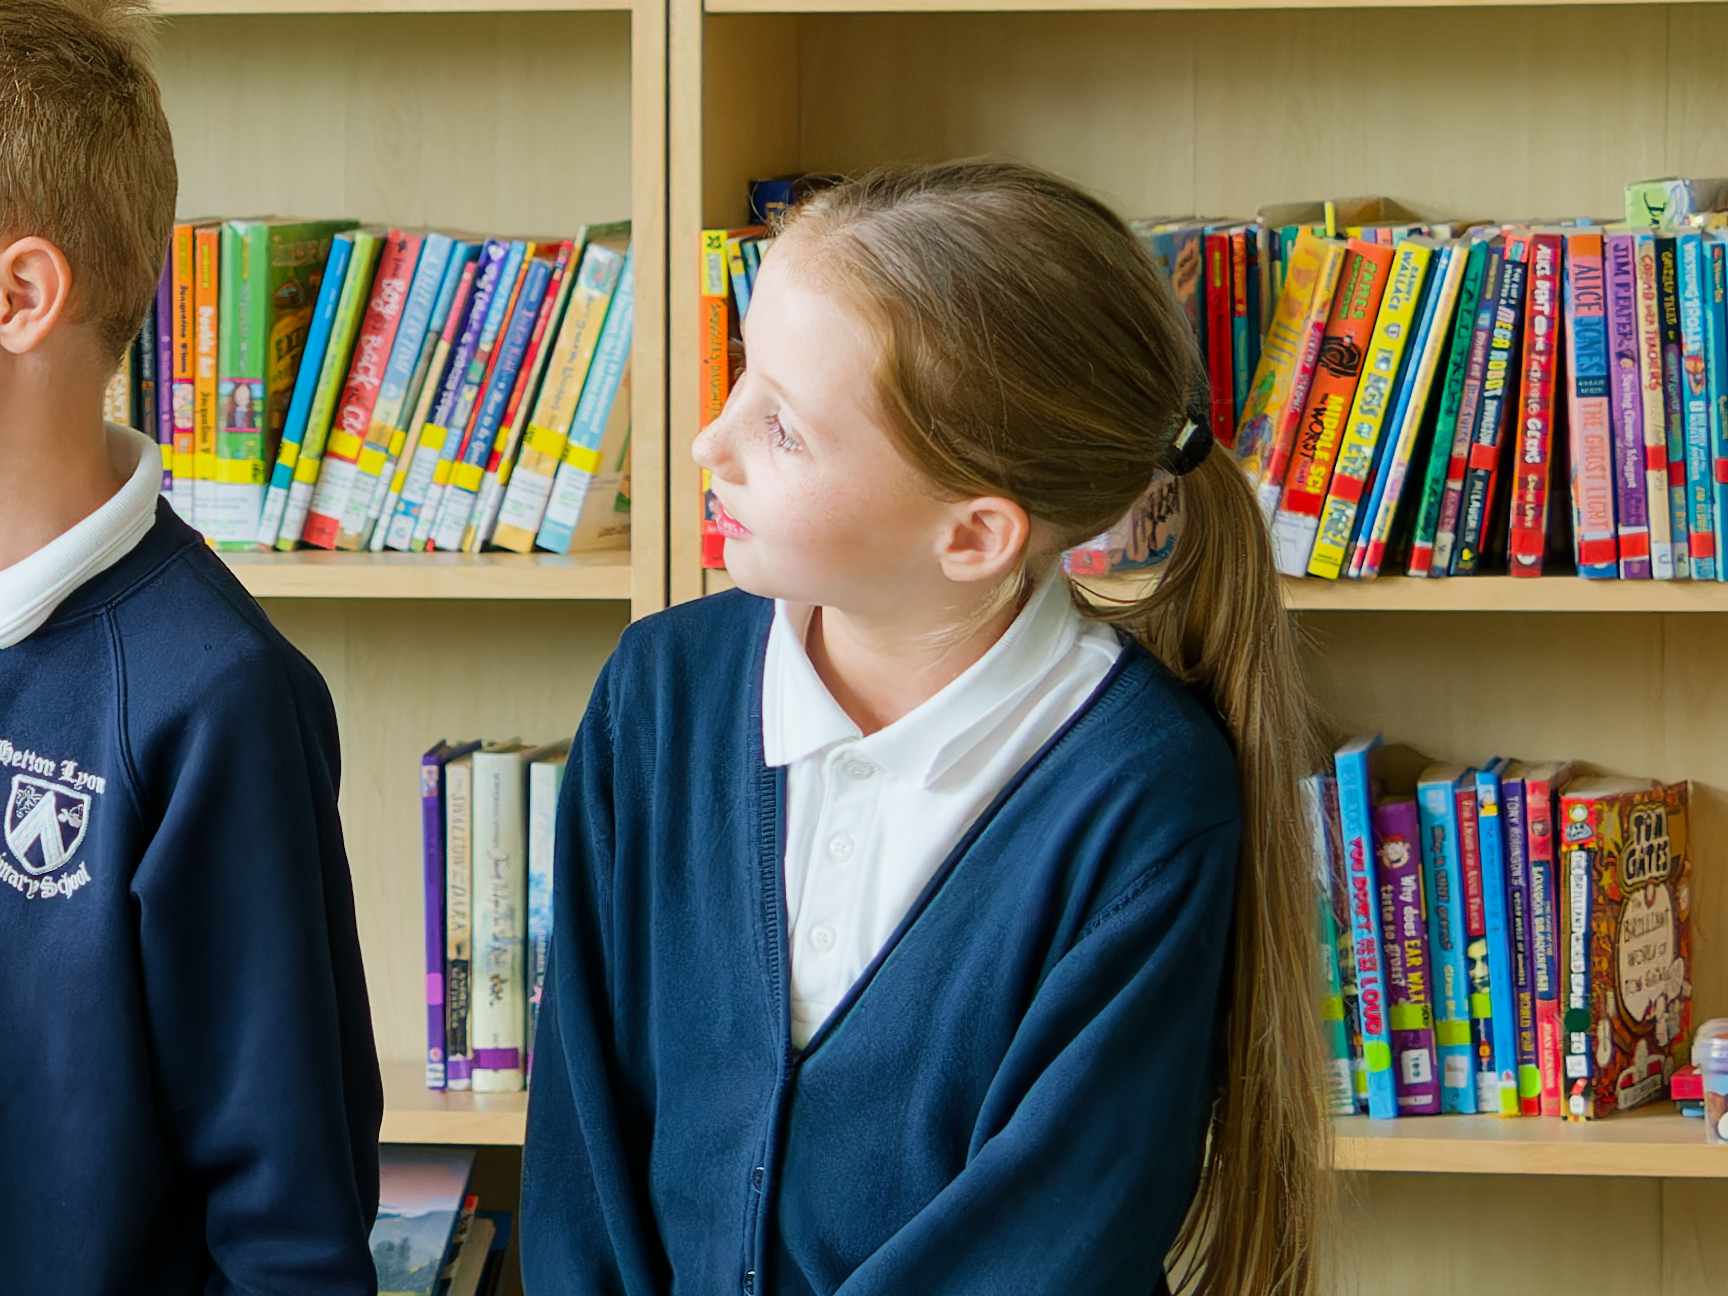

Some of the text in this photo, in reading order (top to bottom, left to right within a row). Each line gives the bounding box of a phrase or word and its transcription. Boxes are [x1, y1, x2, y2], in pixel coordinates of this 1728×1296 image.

[1386, 251, 1414, 311] WALLACE
[1614, 244, 1633, 276] JIM
[1352, 261, 1378, 319] JAMES
[1492, 306, 1516, 348] MEGA
[1574, 264, 1607, 376] ALICE JONES
[1484, 351, 1509, 397] ROBOT
[1298, 404, 1325, 463] WORST
[1314, 395, 1345, 460] MIDDLE
[1525, 418, 1543, 463] GERMS
[1584, 401, 1609, 529] THE GHOST LIGHT
[1507, 796, 1521, 824] TONY
[1634, 807, 1664, 844] TOM
[1349, 837, 1366, 873] YOU
[1626, 841, 1668, 881] GATES
[40, 861, 91, 899] School
[1399, 874, 1426, 1003] Why does EAR WAX
[1361, 976, 1383, 1034] LOUD
